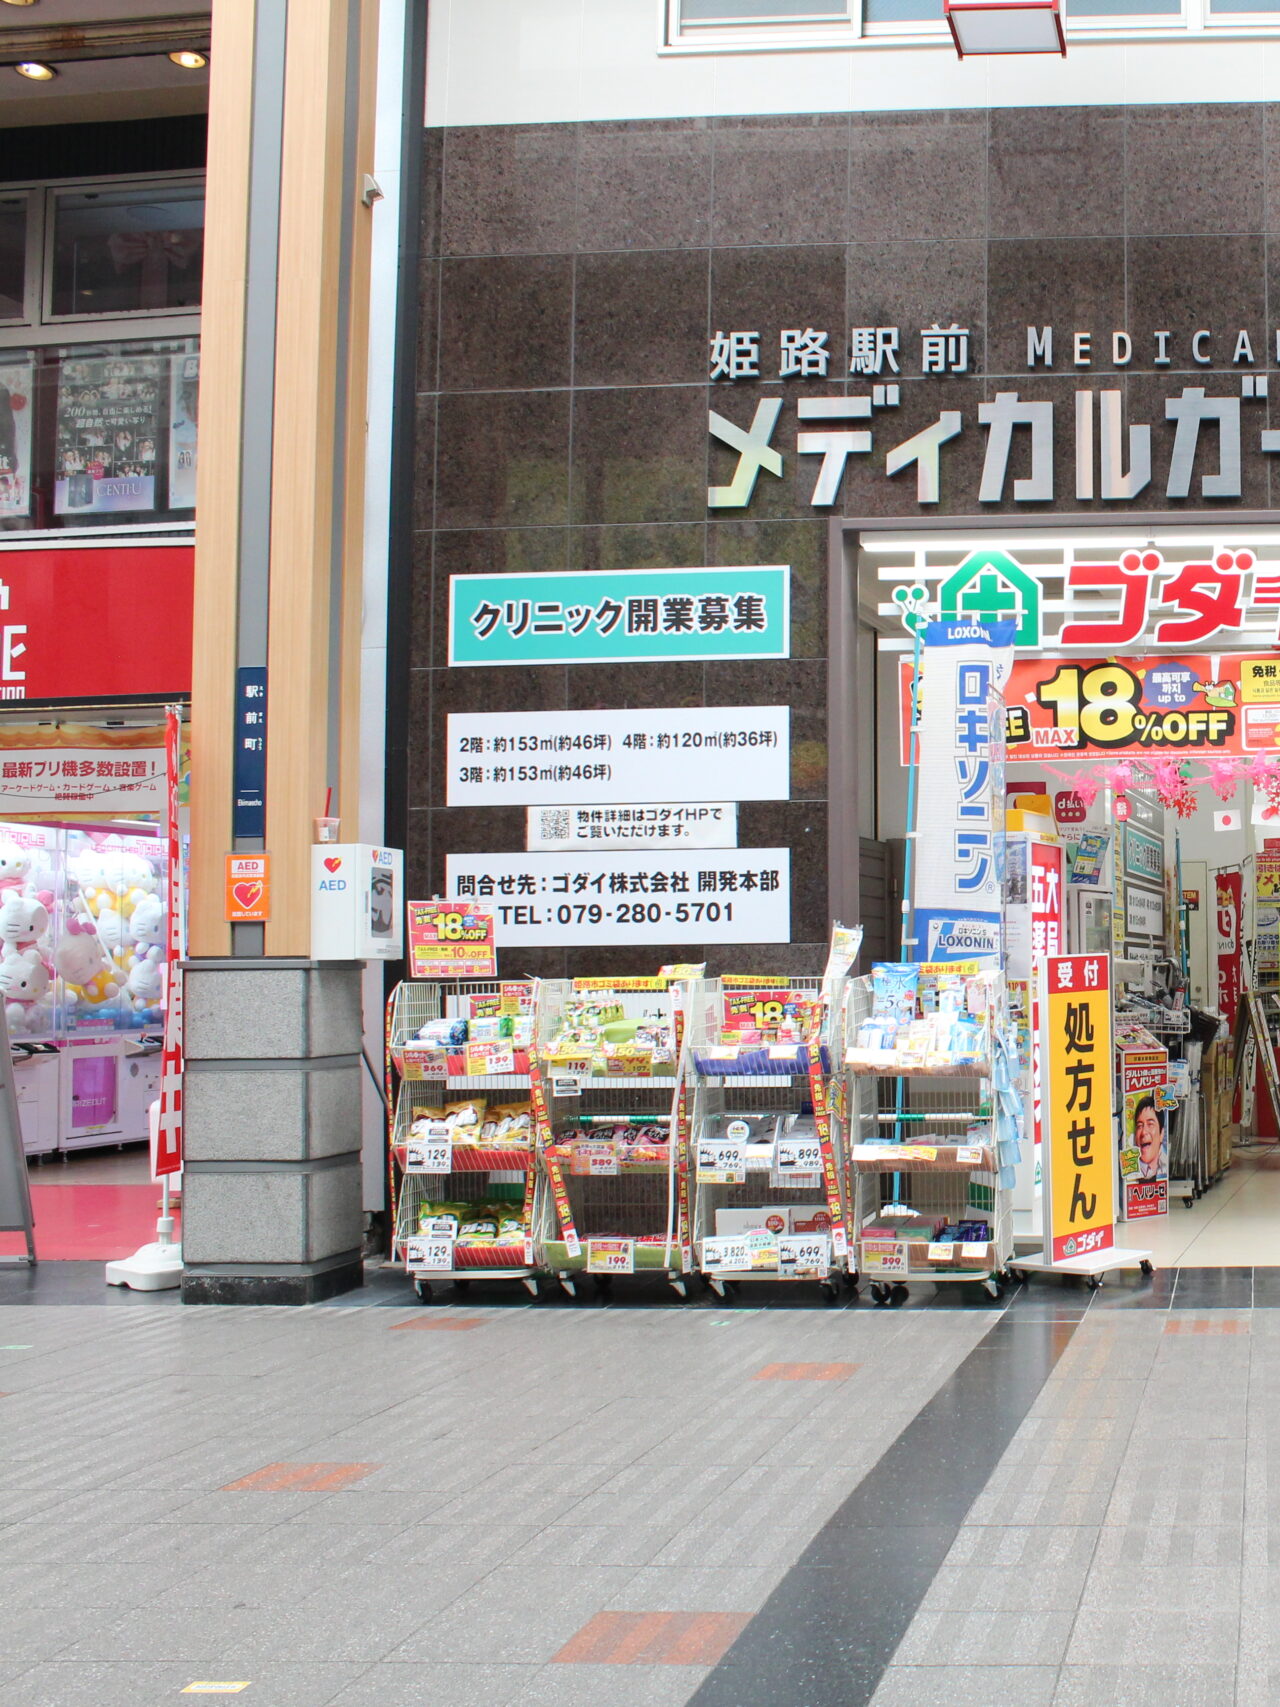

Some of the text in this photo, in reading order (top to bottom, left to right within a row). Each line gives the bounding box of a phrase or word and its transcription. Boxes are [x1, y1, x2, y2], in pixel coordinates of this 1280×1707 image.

[709, 322, 972, 379] 姫路駅前
[471, 594, 767, 637] クリニック開業募集
[1158, 694, 1186, 704] up to
[244, 684, 259, 751] 駅前町
[1034, 729, 1076, 746] MAX
[2, 760, 157, 779] 最新プリ機多数設置!
[955, 660, 993, 893] ロキソニン
[576, 807, 723, 824] 物件詳細はゴダイHPで
[576, 823, 690, 839] ご覧いただけます。
[237, 861, 259, 871] AED
[379, 852, 393, 866] AED
[319, 880, 347, 891] AED
[697, 870, 779, 893] 開発本部
[938, 935, 994, 949] LOXONIN
[1057, 959, 1100, 990] 受付
[1064, 1002, 1097, 1223] 処方せん
[428, 1149, 447, 1160] 129
[718, 1151, 739, 1161] 699
[799, 1149, 819, 1159] 899
[1076, 1230, 1105, 1253] ゴダイ
[428, 1246, 447, 1257] 129
[800, 1246, 820, 1257] 699
